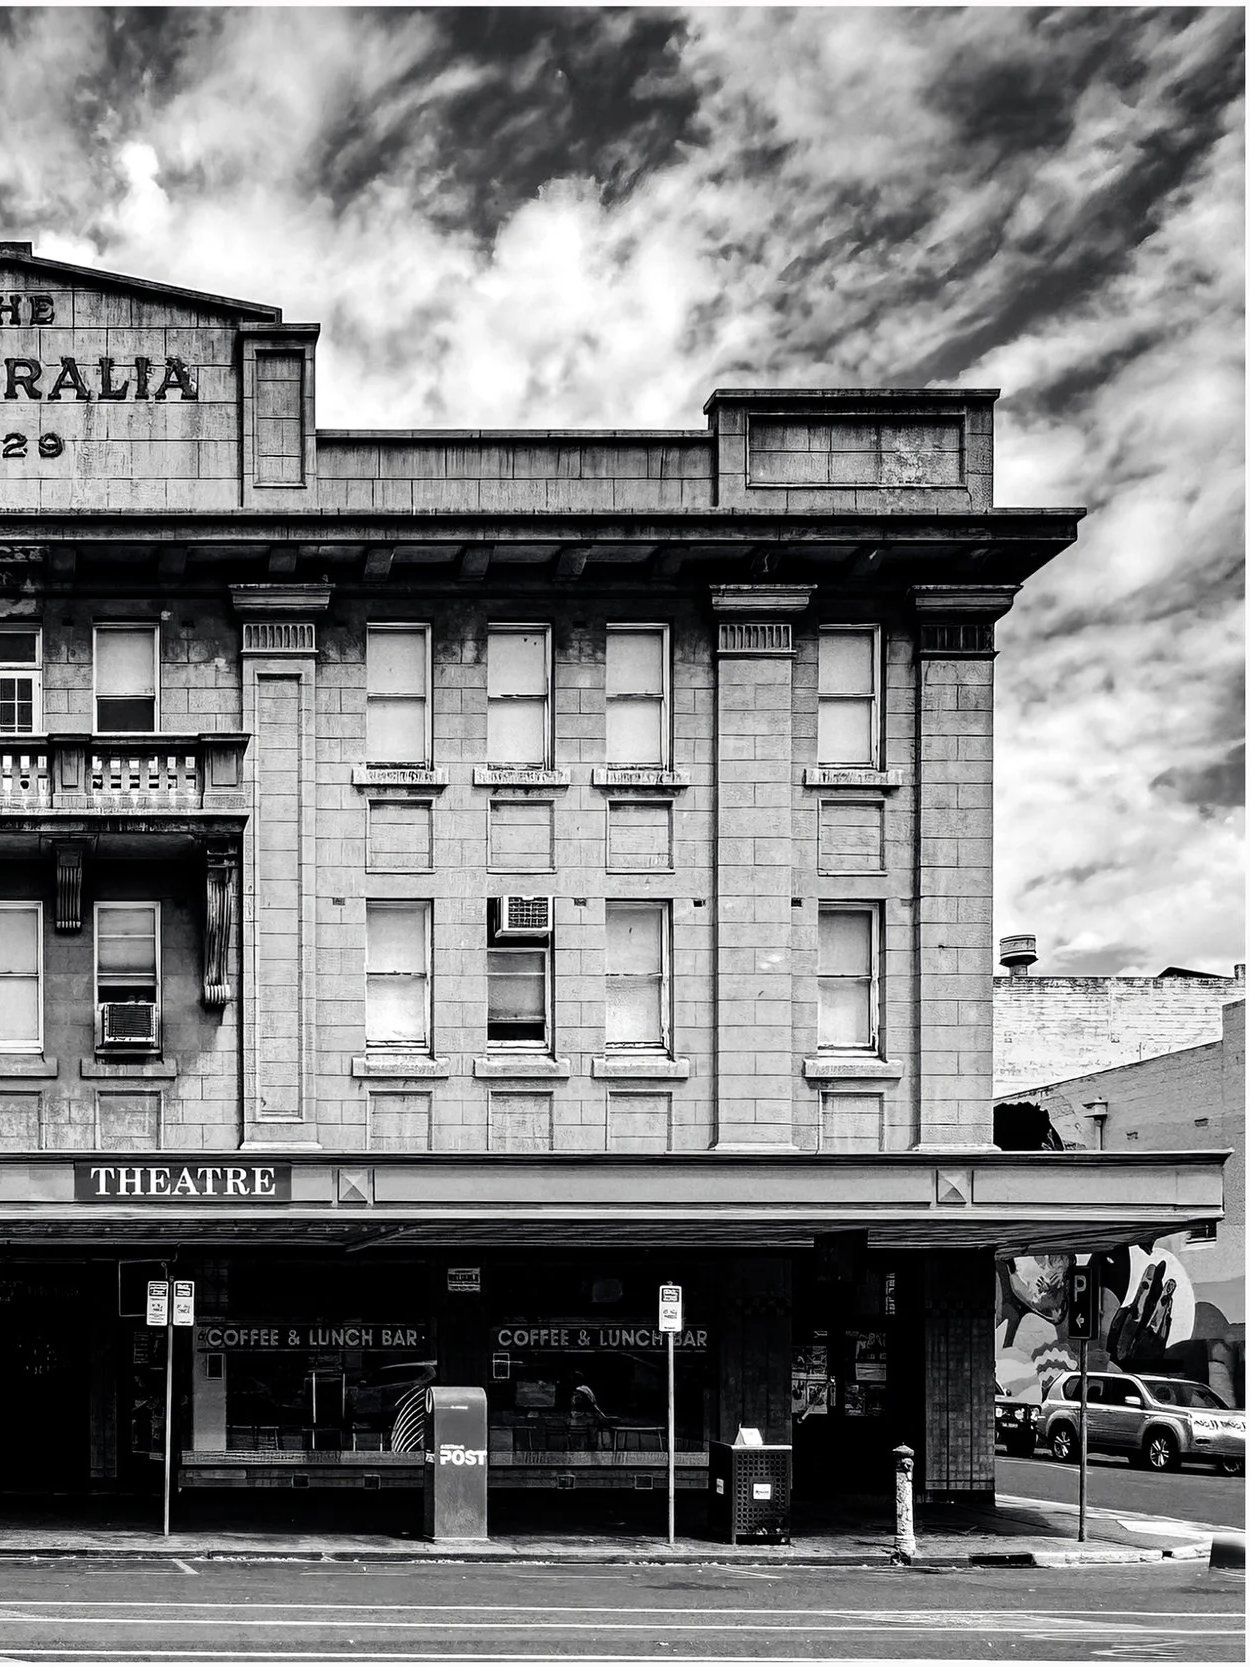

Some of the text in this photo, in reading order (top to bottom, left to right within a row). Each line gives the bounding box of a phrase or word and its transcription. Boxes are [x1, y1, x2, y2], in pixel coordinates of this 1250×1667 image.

[90, 1166, 276, 1196] THEATRE
[1074, 1275, 1087, 1302] P
[207, 1328, 417, 1347] COFFEE & LUNCH BAR
[498, 1328, 707, 1347] COFFEE & LUNCH BAR
[440, 1449, 487, 1466] POST
